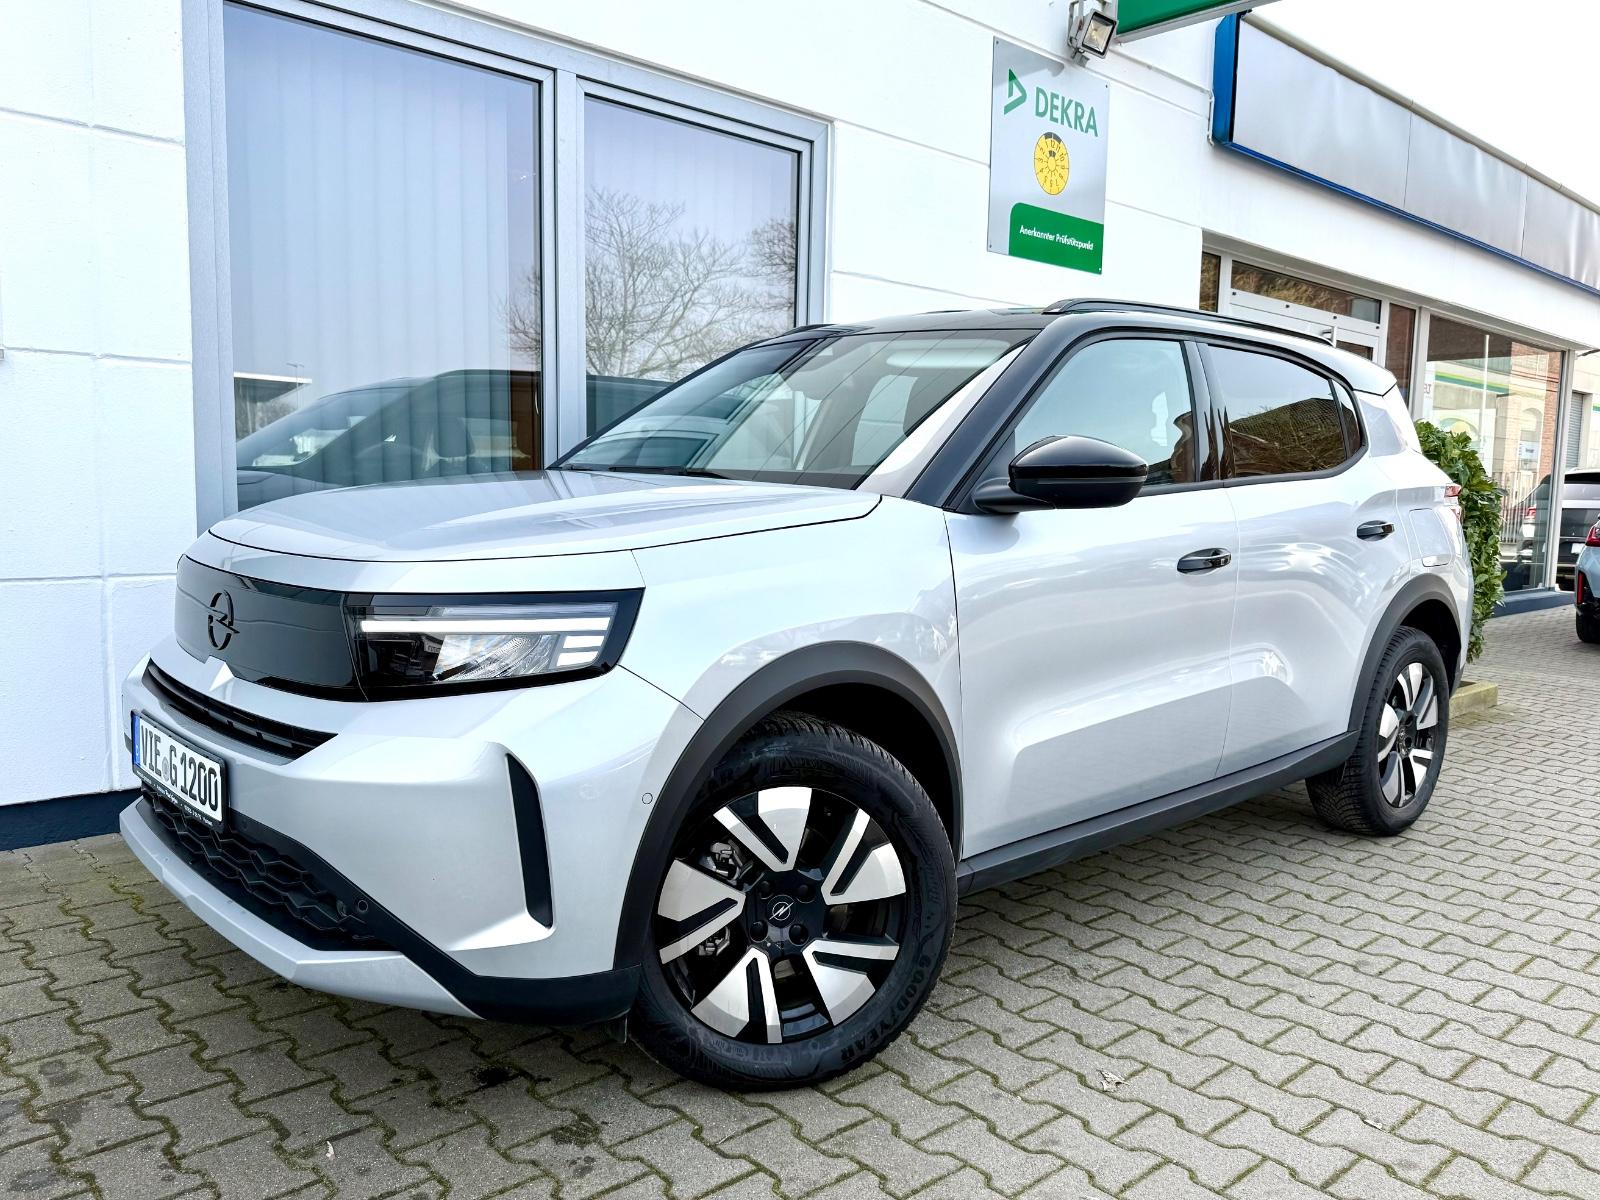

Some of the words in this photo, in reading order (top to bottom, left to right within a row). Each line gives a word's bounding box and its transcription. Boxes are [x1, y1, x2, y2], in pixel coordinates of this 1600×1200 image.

[1035, 86, 1098, 137] DEKRA
[1019, 224, 1055, 241] Anerkannter
[1055, 233, 1094, 251] Prüfstützpunkt
[141, 724, 162, 777] VIE
[169, 744, 178, 788] G
[180, 751, 218, 812] 1200
